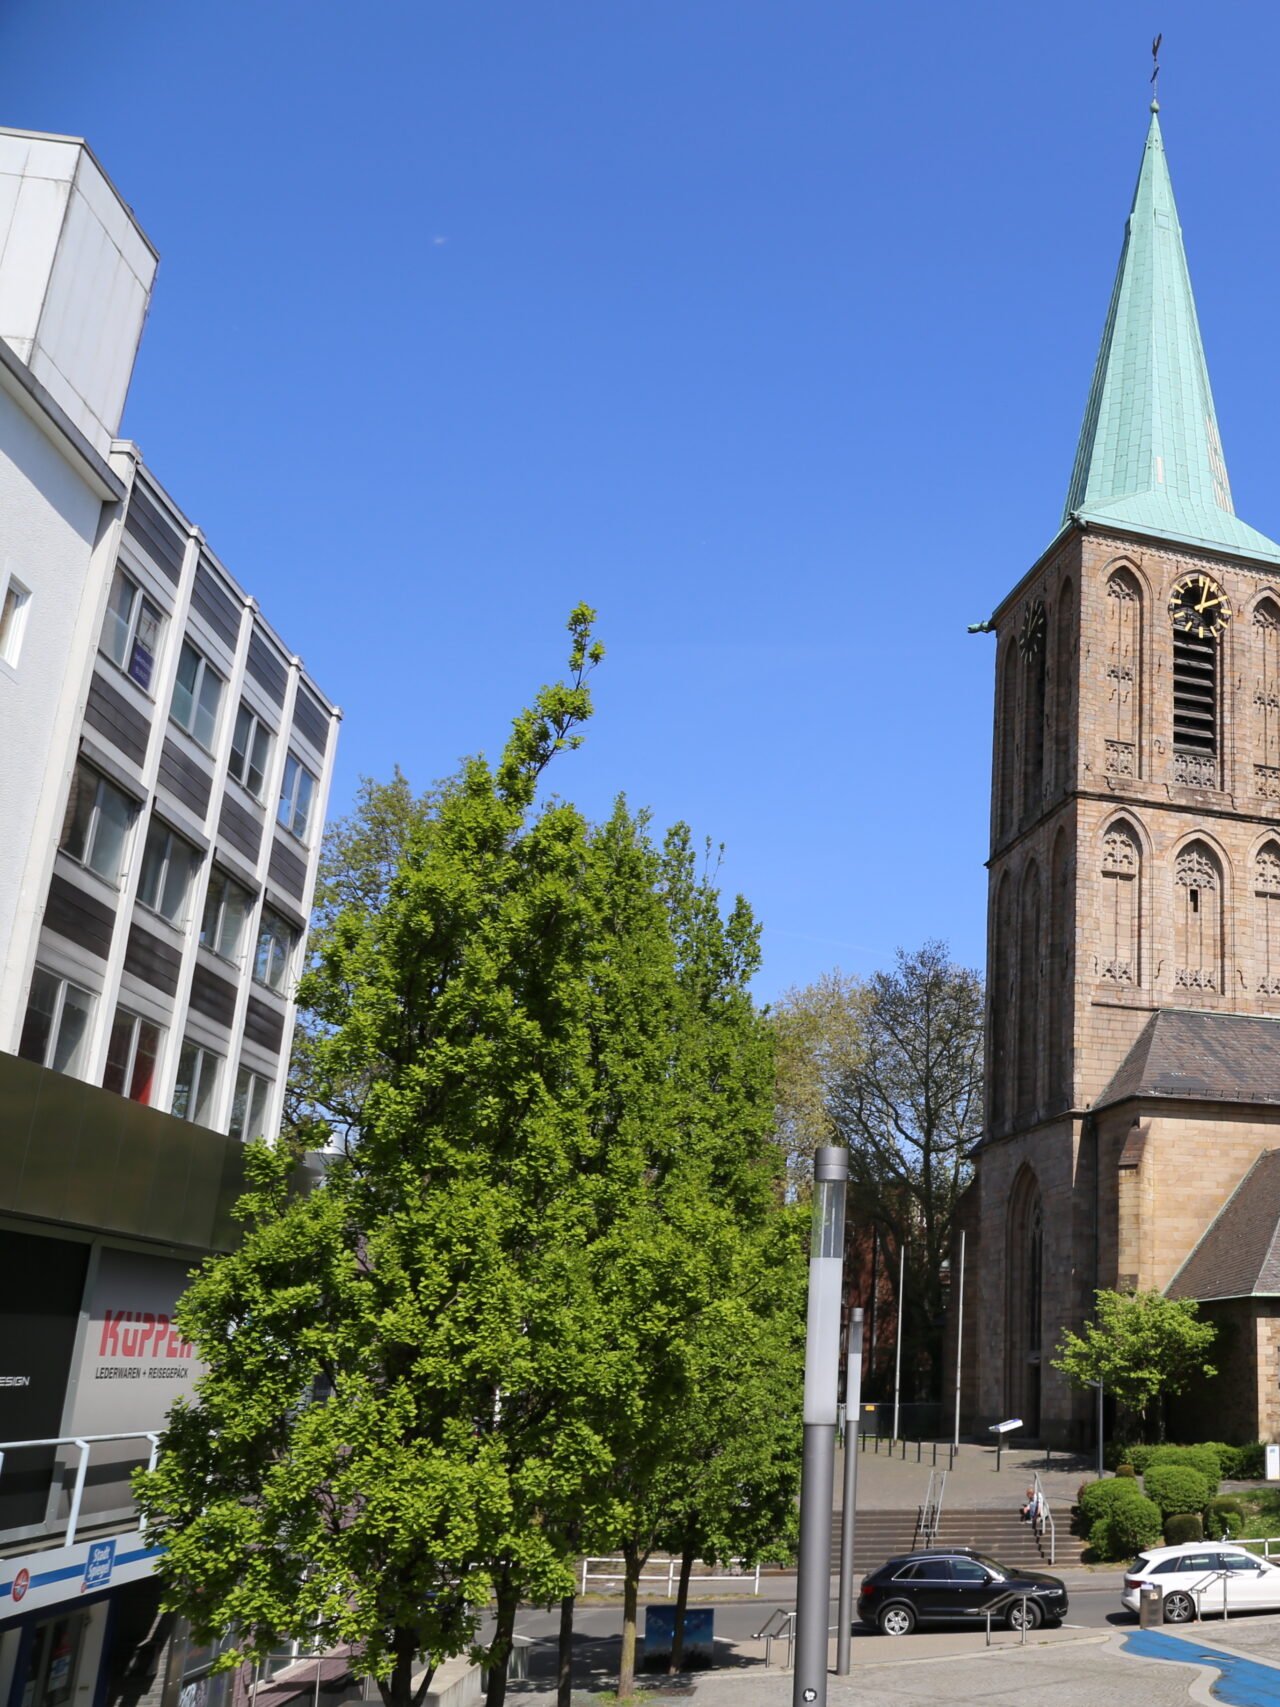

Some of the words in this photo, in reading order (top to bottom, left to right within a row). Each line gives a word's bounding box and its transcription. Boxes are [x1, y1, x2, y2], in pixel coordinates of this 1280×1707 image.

[95, 1367, 141, 1380] LEDERWAREN
[147, 1364, 189, 1380] REISEGEPÄCK
[92, 1545, 111, 1563] Stadt
[87, 1558, 112, 1581] Spiegel
